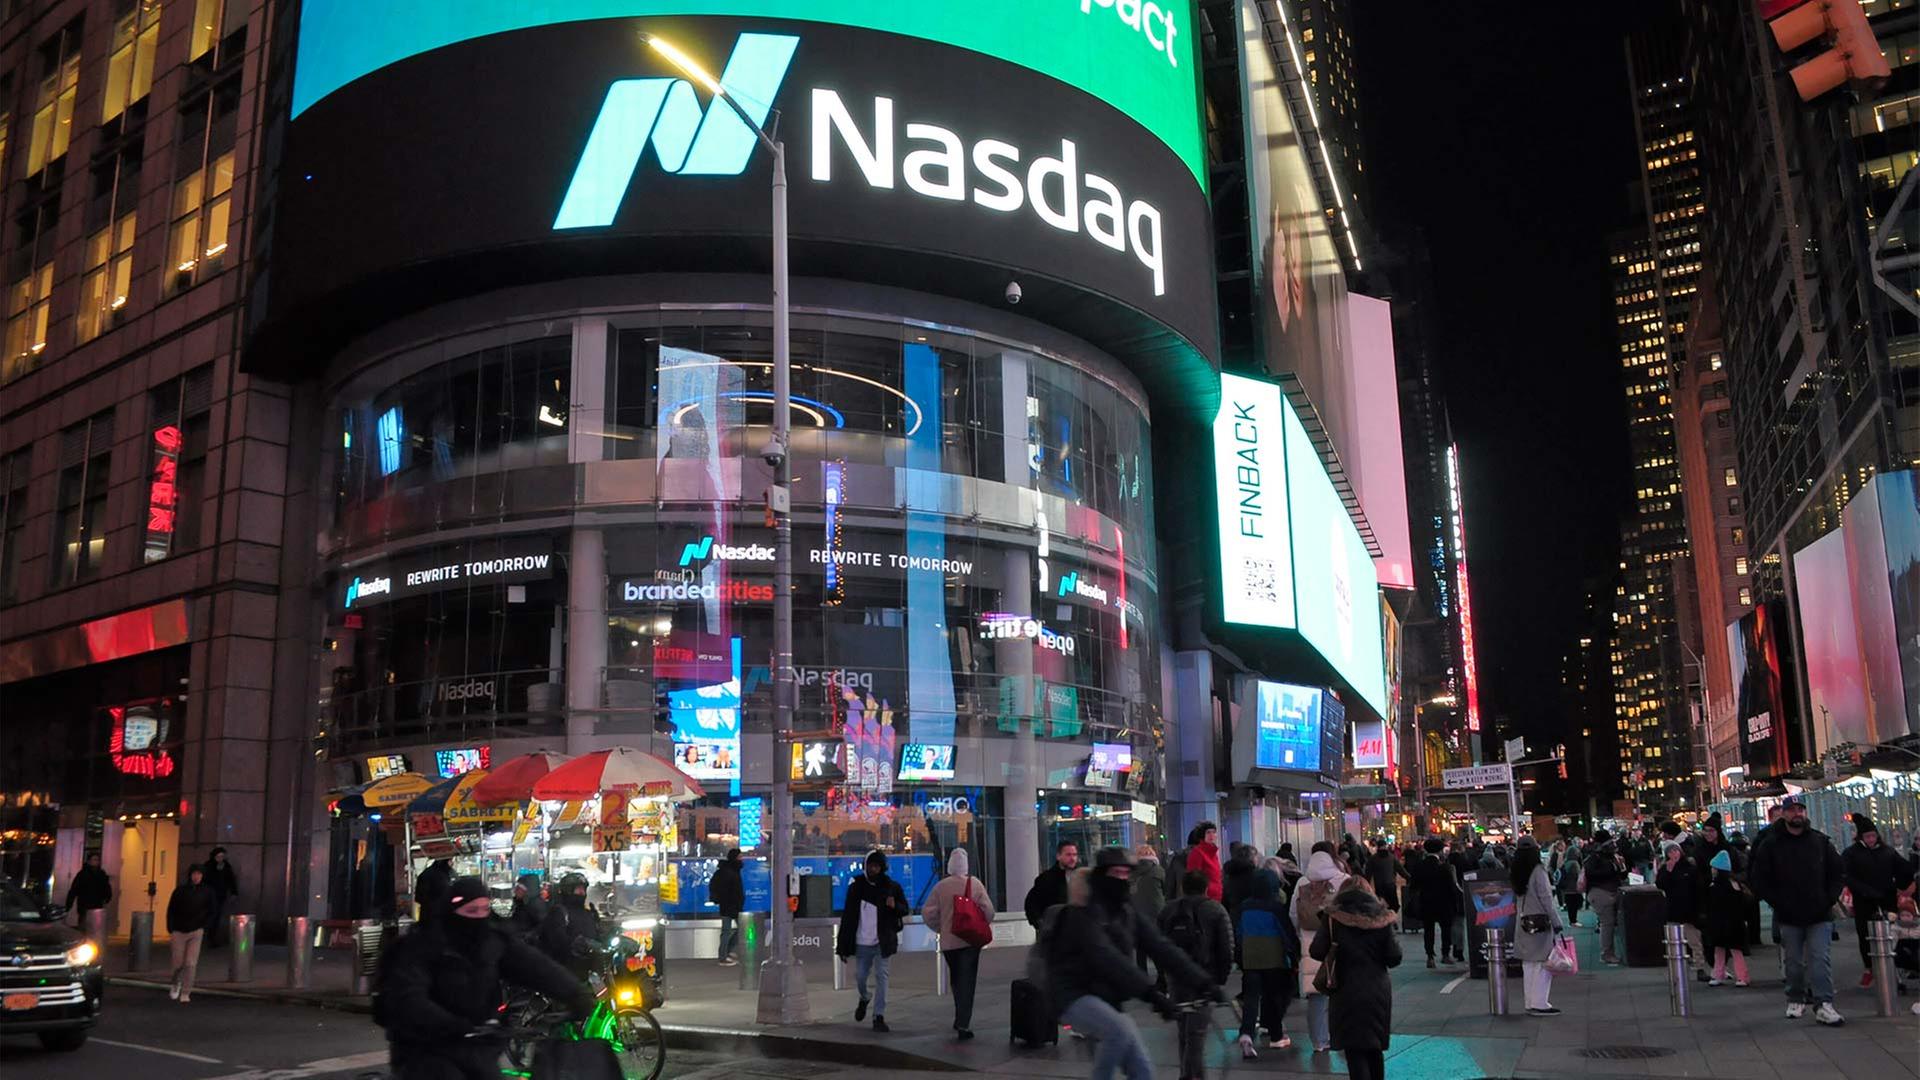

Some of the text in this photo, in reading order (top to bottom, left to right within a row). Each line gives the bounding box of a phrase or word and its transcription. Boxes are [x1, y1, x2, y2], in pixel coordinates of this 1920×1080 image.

[810, 87, 1165, 296] Nasdaq
[1233, 401, 1264, 539] FINBACK
[407, 555, 549, 586] REWRITE TOMORROW
[810, 550, 973, 575] REWRITE TOMORROW
[358, 577, 391, 598] Nasdaq
[624, 580, 775, 601] brandedcities
[1076, 580, 1107, 605] Nasdaq
[438, 678, 496, 701] Nasdaq
[791, 667, 873, 692] Nasdaq
[450, 806, 514, 817] SABRETT
[792, 934, 821, 947] sdaq
